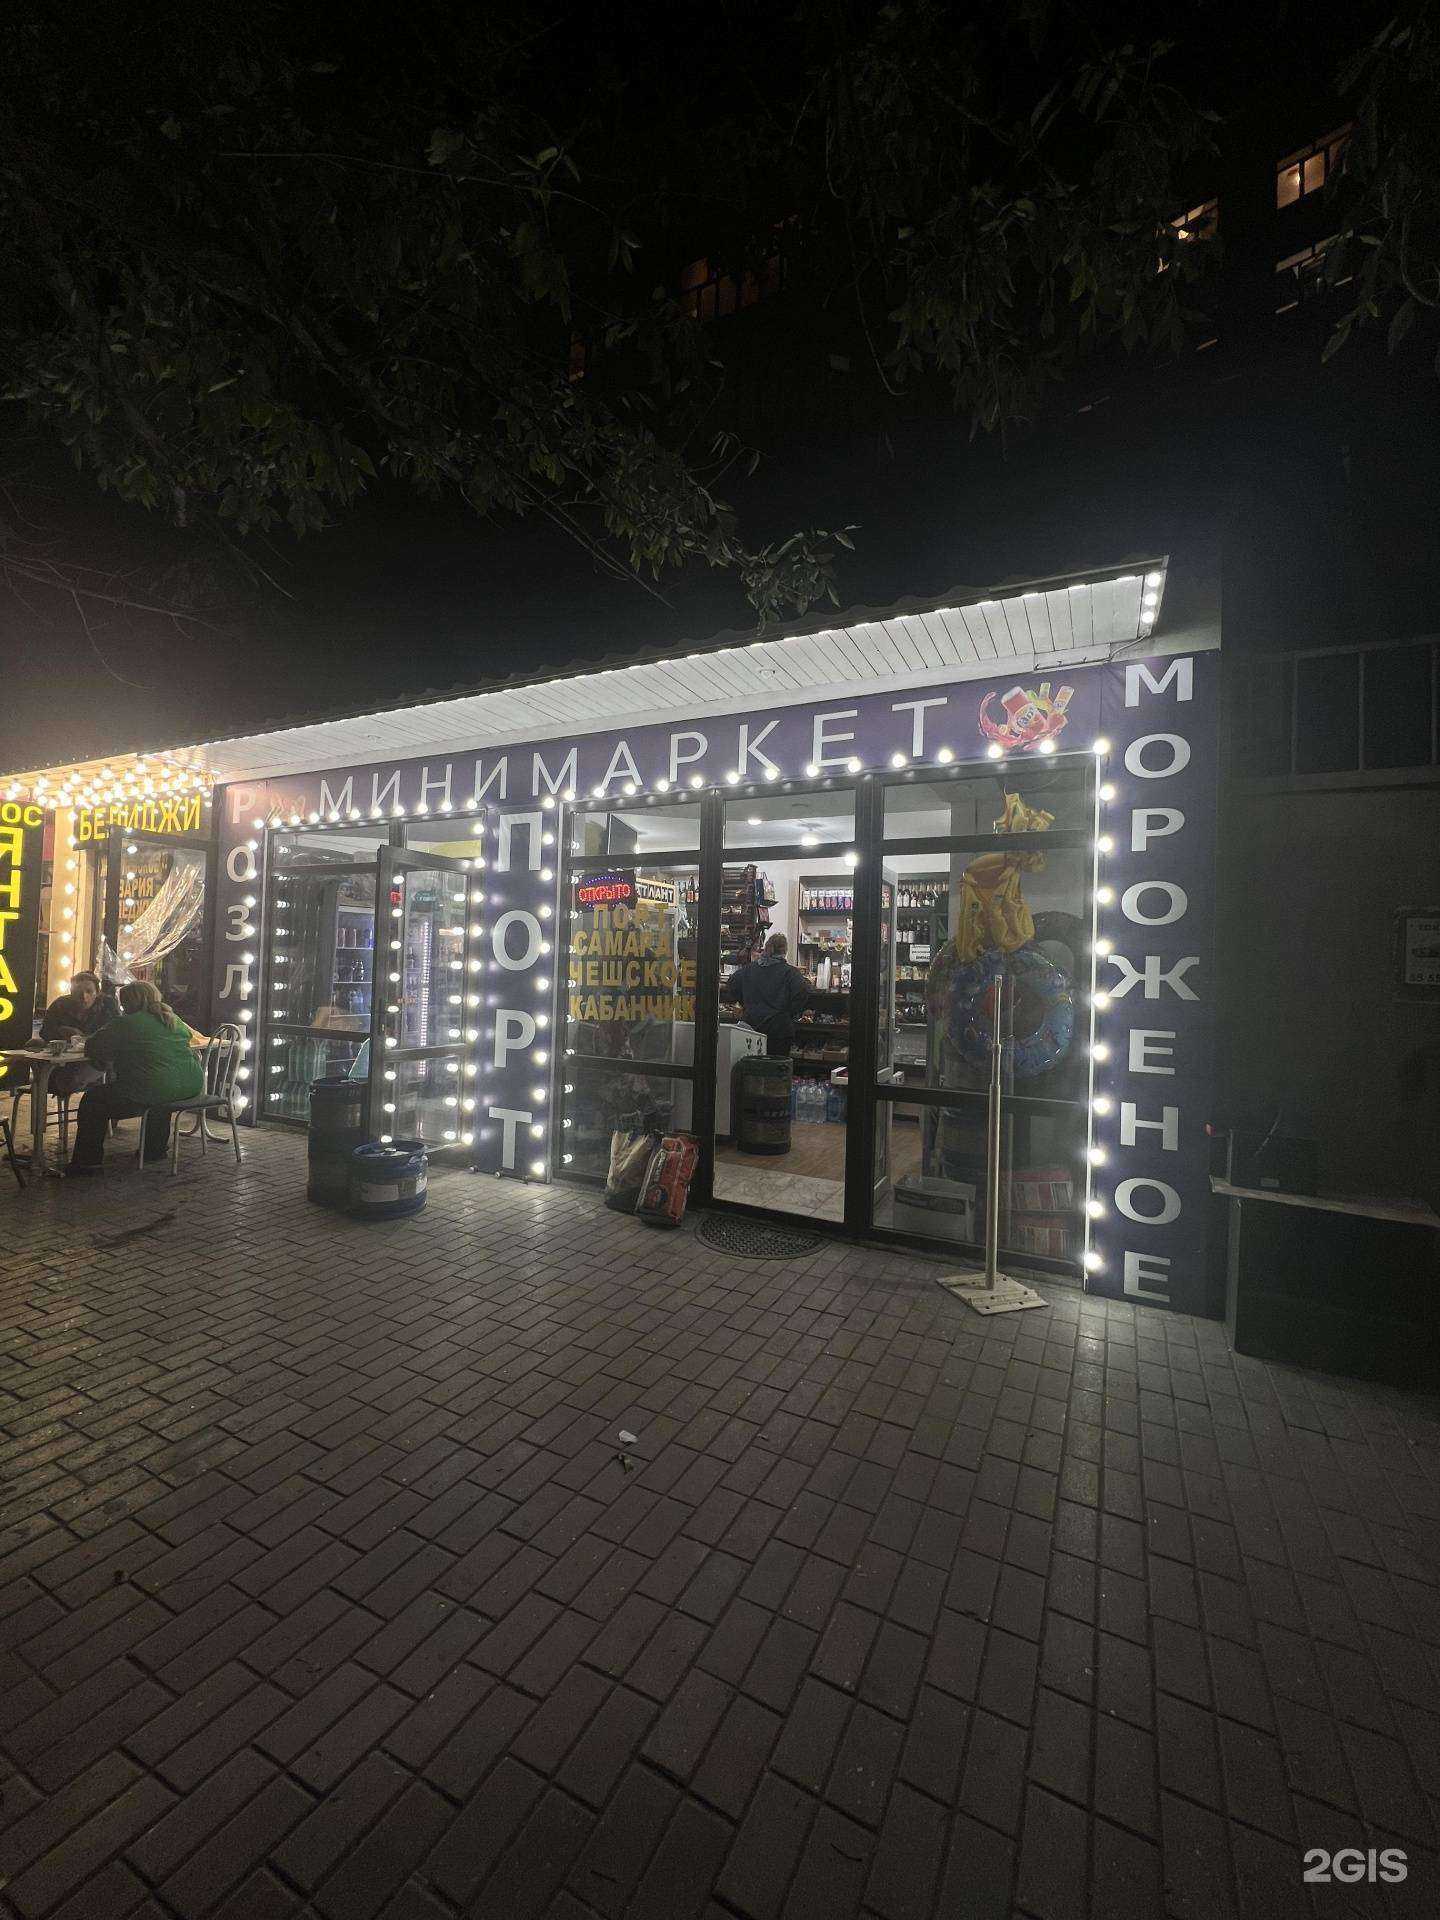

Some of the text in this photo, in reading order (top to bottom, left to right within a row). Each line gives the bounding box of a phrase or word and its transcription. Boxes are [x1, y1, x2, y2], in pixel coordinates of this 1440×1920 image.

[0, 802, 43, 826] ОС
[578, 884, 631, 902] ОТКРЫТО
[593, 903, 669, 929] ПОРТ
[573, 930, 672, 956] САМАРА
[569, 960, 697, 988] ЧЕШСКОЕ
[1108, 657, 1200, 1302] МОРОЖЕНОЕ
[488, 811, 544, 1170] ПОРТ
[569, 994, 697, 1022] КАБАНЧИК
